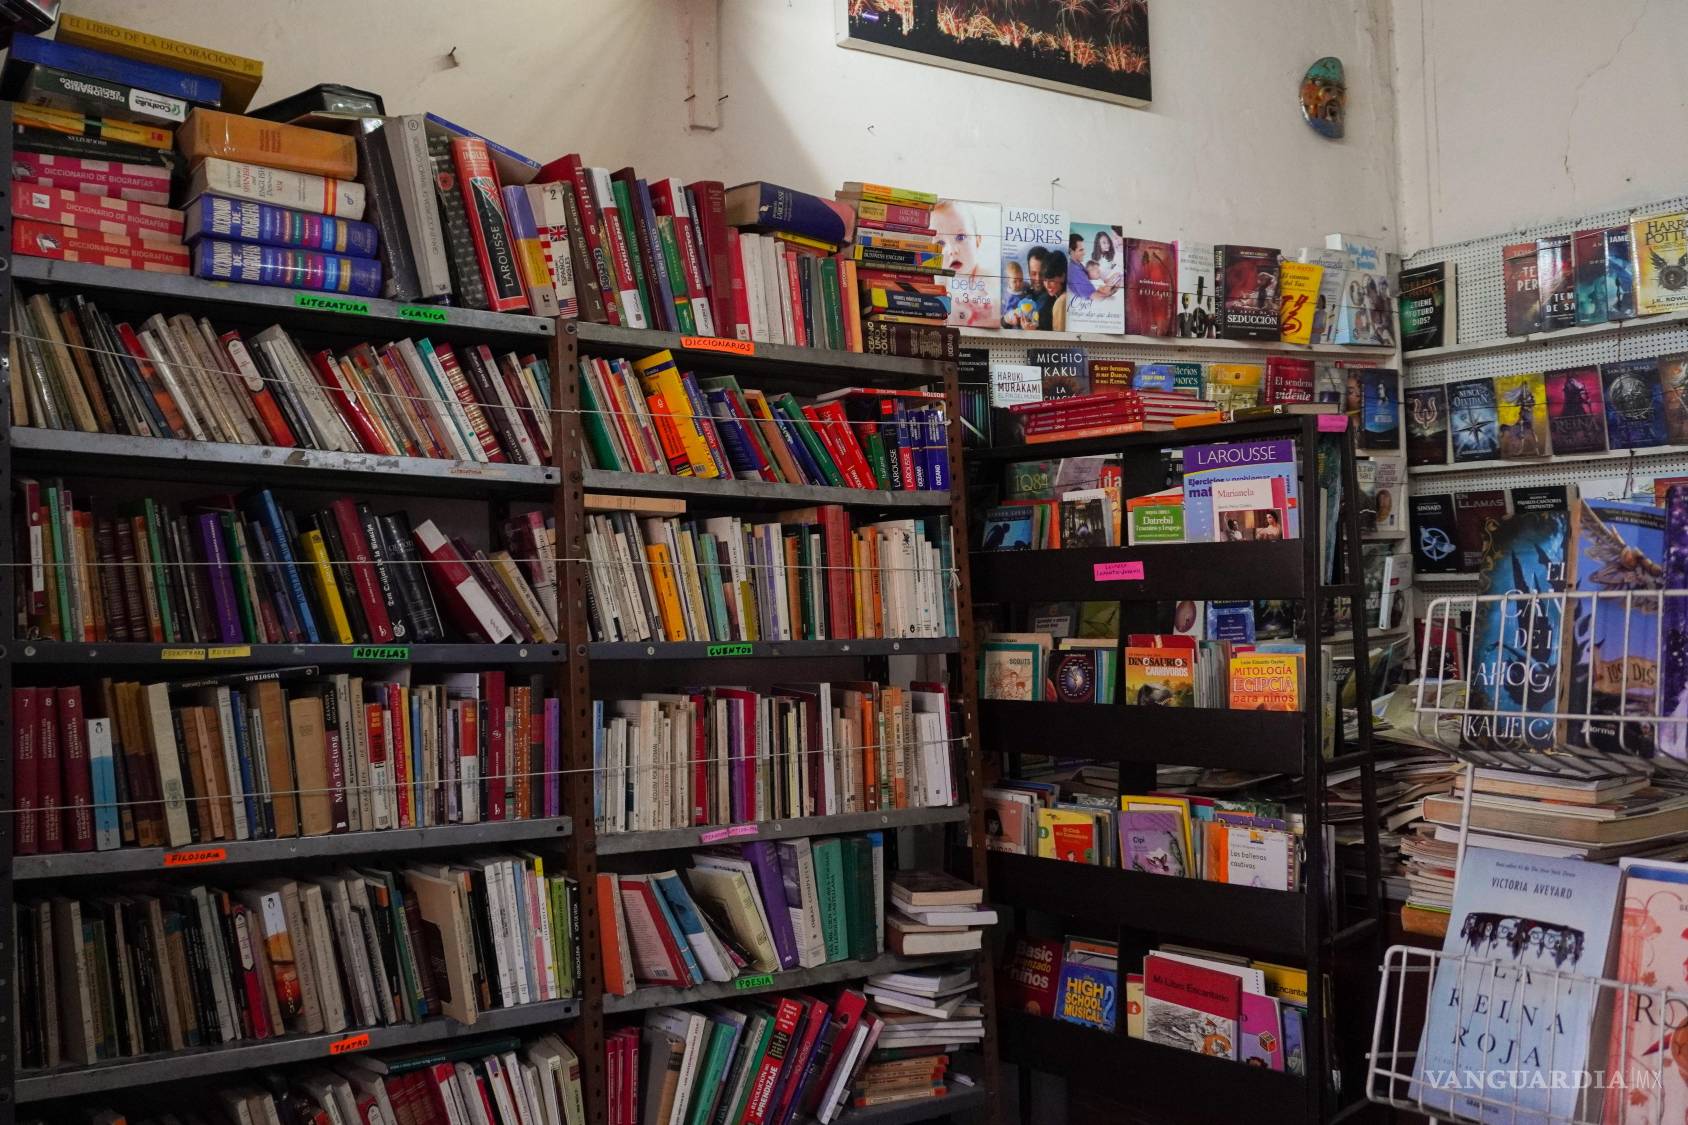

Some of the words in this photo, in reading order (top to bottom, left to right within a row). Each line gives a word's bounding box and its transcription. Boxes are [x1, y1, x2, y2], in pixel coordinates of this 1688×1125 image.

[69, 19, 81, 29] EL
[86, 22, 121, 39] LIBRO
[124, 30, 140, 42] DE
[142, 34, 157, 47] LA
[64, 81, 125, 102] DICCIONARIO
[134, 97, 171, 113] Coahuila
[44, 168, 97, 182] DICCIONARIO
[98, 173, 108, 184] DE
[551, 189, 557, 200] 2
[66, 202, 113, 220] DICCIONARIO
[116, 212, 126, 222] DE
[232, 210, 242, 224] DE
[1009, 211, 1060, 224] LAROUSSE
[1005, 226, 1063, 244] PADRES
[69, 240, 116, 254] DICCIONARIO
[119, 246, 129, 256] DE
[614, 215, 633, 282] COAHUILENSE
[232, 253, 242, 266] DE
[490, 226, 514, 288] LAROUSSE
[684, 224, 701, 290] COAHUILENSE
[300, 298, 368, 312] LITERATURA
[962, 293, 970, 304] 3
[401, 309, 445, 321] CLASICA
[1227, 315, 1277, 324] SEDUCCIÓN
[685, 338, 750, 350] DICCIONARIOS
[1037, 353, 1083, 364] MICHIO
[997, 372, 1023, 381] HARUKI
[1043, 367, 1077, 377] KAKU
[998, 382, 1040, 394] MURAKAMI
[1275, 377, 1283, 386] El
[1285, 378, 1312, 387] sendero
[1056, 386, 1066, 394] LA
[1275, 389, 1311, 400] vidente
[1554, 420, 1600, 433] REINA
[1198, 446, 1277, 465] LAROUSSE
[889, 449, 899, 488] LAROUSSE
[903, 453, 912, 488] LAROUSSE
[1016, 473, 1048, 492] 1Q84
[1217, 489, 1255, 498] Marianela
[1458, 500, 1504, 508] LLAMAS
[1514, 630, 1541, 649] DE
[356, 648, 406, 659] NOVELAS
[710, 646, 752, 656] CUENTOS
[1128, 657, 1188, 667] DINOSAURIOS
[1235, 664, 1292, 676] MITOLOGÍA
[1232, 677, 1294, 692] EGIPCIA
[23, 698, 29, 708] 7
[45, 698, 52, 706] 8
[68, 699, 75, 708] 9
[1233, 695, 1258, 704] para
[1263, 694, 1294, 703] niños
[335, 784, 343, 803] Mao
[1132, 836, 1144, 844] Cipi
[1491, 877, 1528, 892] VICTORIA
[1533, 883, 1573, 899] AVEYARD
[1494, 959, 1532, 985] LA
[739, 977, 771, 988] POESIA
[1067, 977, 1104, 998] HIGH
[1153, 975, 1161, 983] Mi
[1163, 979, 1186, 990] Libro
[1186, 984, 1229, 1002] Encantado
[1065, 992, 1103, 1011] SCHOOL
[1103, 986, 1114, 1020] 2
[1064, 1003, 1103, 1024] MUSICAL
[1448, 988, 1564, 1035] REINA
[333, 1039, 369, 1053] TEATRO
[1451, 1027, 1542, 1067] ROJA
[756, 1066, 778, 1117] APRENDIZAJE
